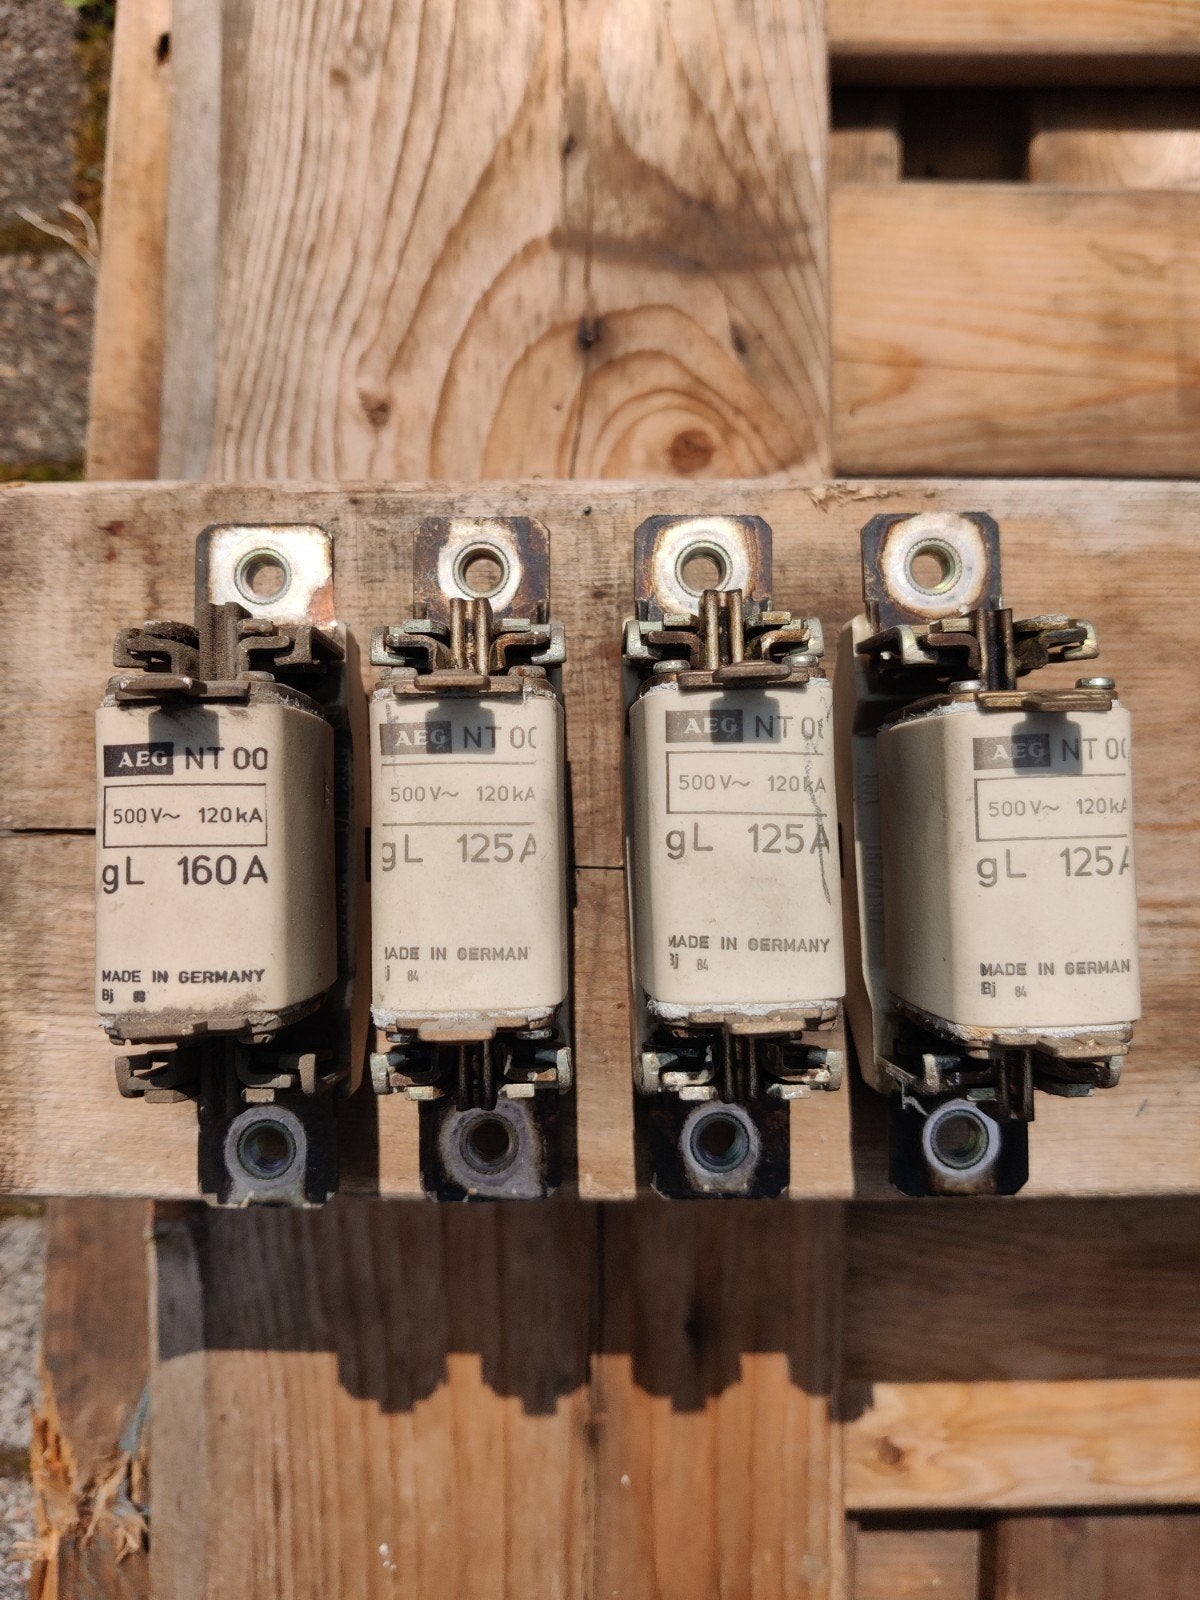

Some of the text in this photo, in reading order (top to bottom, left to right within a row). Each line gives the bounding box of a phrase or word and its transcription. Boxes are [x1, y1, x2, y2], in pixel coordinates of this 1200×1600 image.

[683, 717, 738, 735] AEG
[755, 715, 793, 739] NT
[395, 729, 446, 747] AEG
[463, 726, 502, 749] NT
[117, 747, 268, 770] AEG NT 00
[991, 743, 1045, 761] AEG
[1061, 738, 1098, 762] NT
[768, 775, 826, 793] 120kA
[476, 785, 536, 802] 120kA
[198, 807, 263, 824] 120kA
[457, 832, 537, 863] 125A
[666, 822, 830, 860] gL 125A
[102, 855, 268, 894] gL 160A
[976, 849, 1027, 888] gL
[720, 936, 737, 950] IN
[747, 937, 830, 953] GERMANY
[384, 946, 531, 961] ADE IN GERMAN
[696, 958, 709, 971] 84
[980, 962, 1027, 976] MADE
[1038, 962, 1055, 976] IN
[101, 969, 266, 984] MADE IN GERMANY
[407, 969, 419, 983] 84
[102, 988, 114, 1004] Bj
[981, 981, 1027, 998] Bj 84
